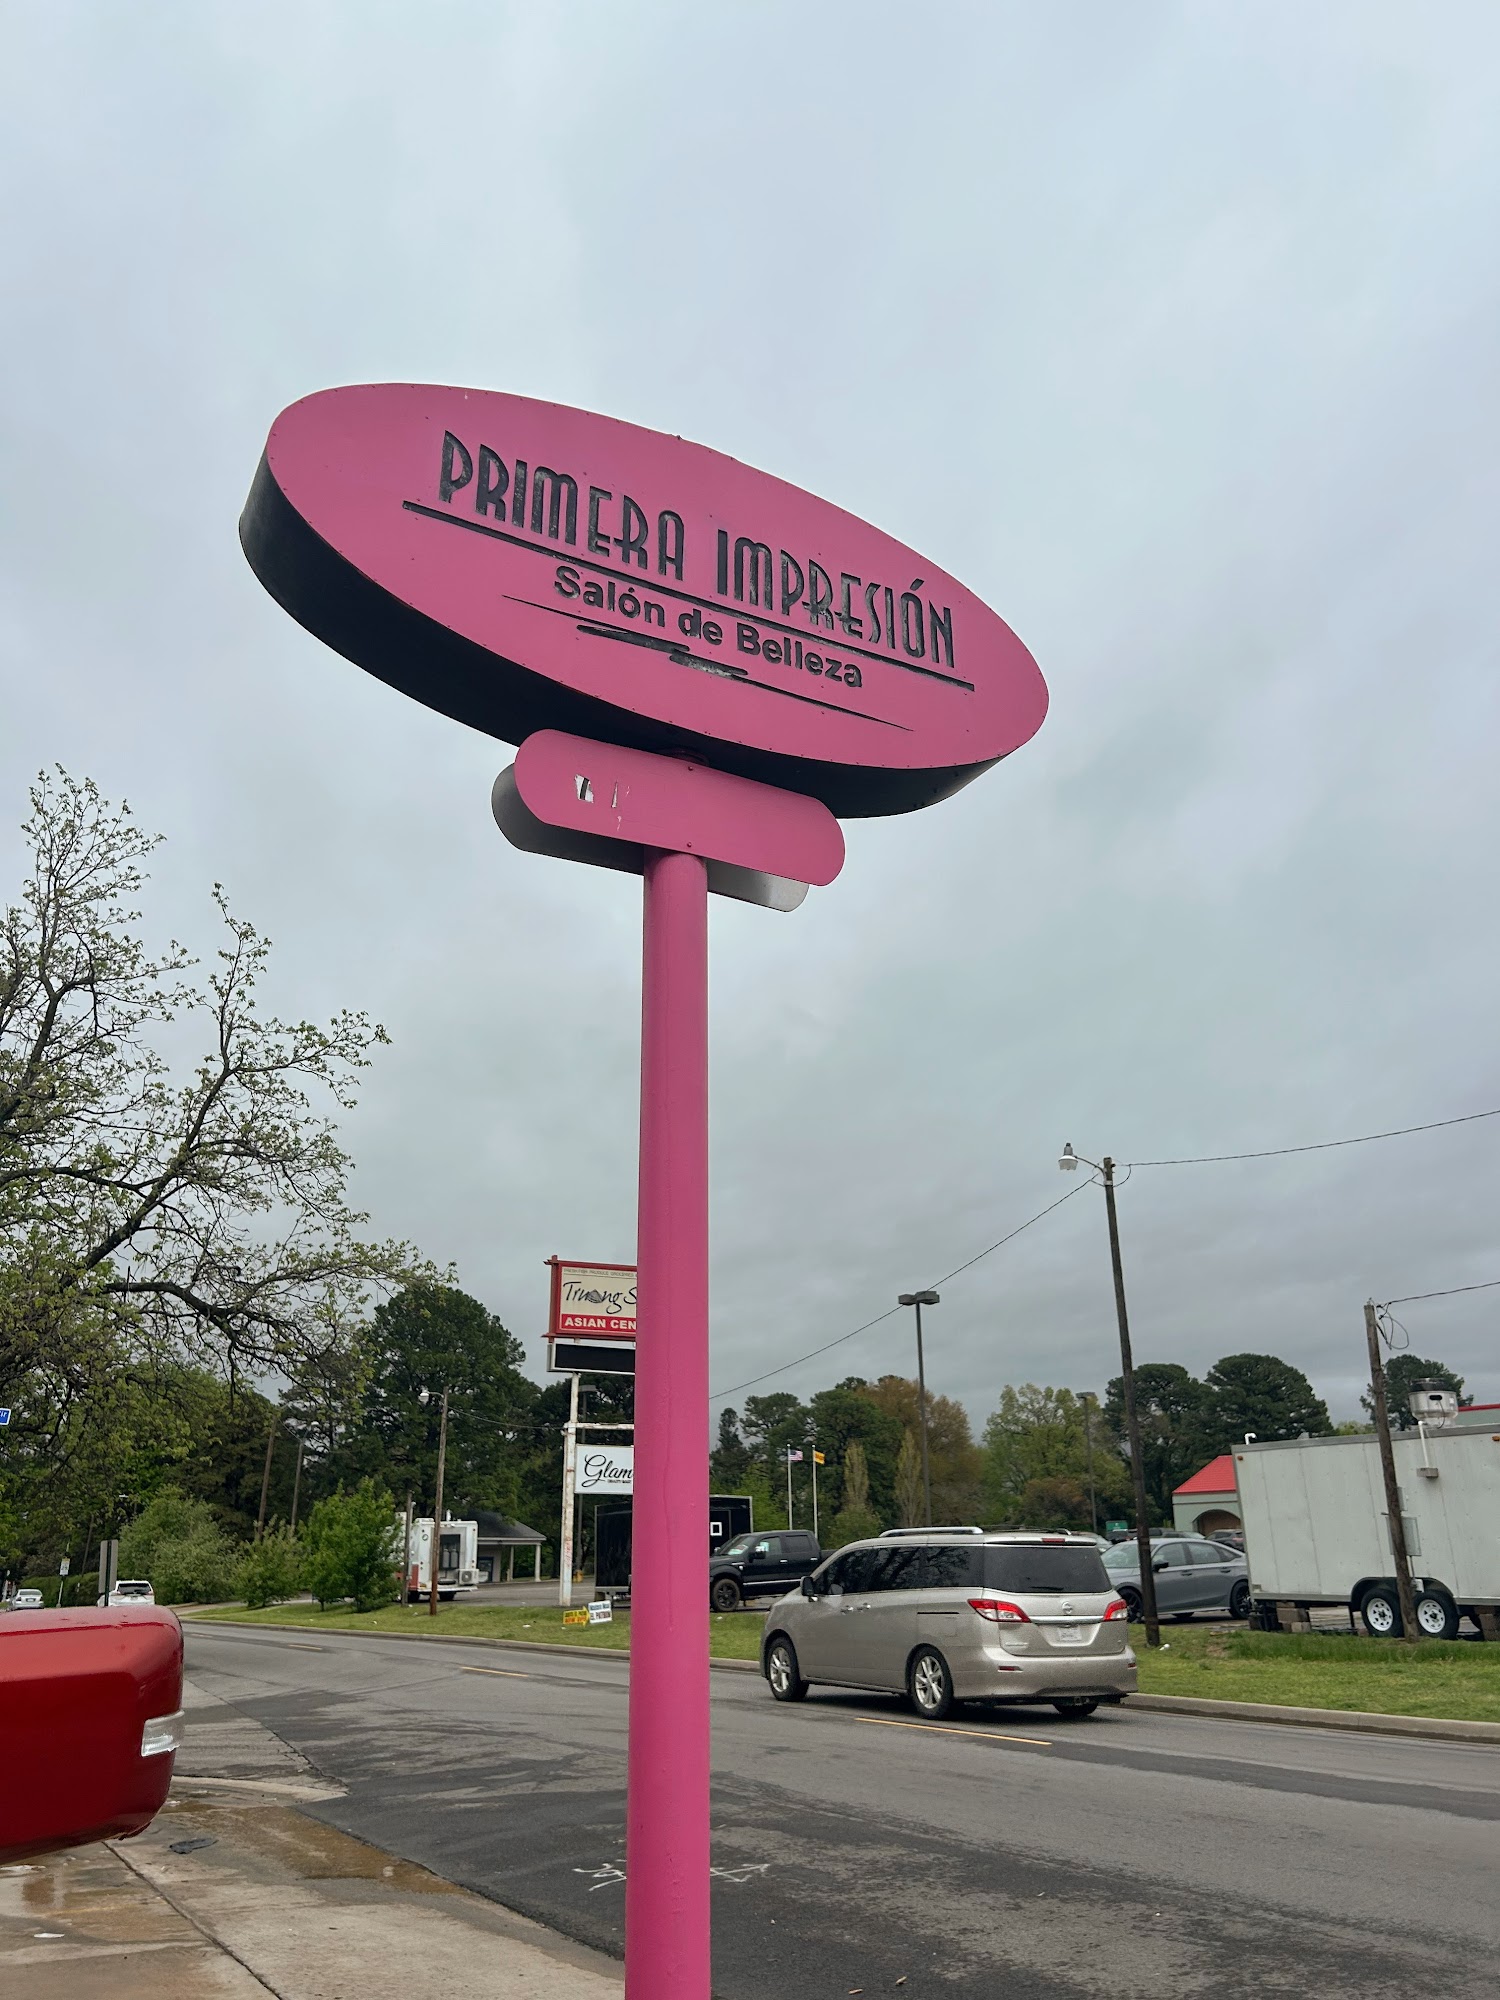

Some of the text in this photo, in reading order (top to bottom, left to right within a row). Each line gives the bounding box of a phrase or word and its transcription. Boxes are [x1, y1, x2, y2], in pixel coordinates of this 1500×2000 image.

[439, 430, 955, 669] PRIMERA IMPRESIÓN
[554, 565, 863, 688] Salón de Belleza
[564, 1317, 636, 1330] ASIAN CEN
[624, 1286, 637, 1305] S
